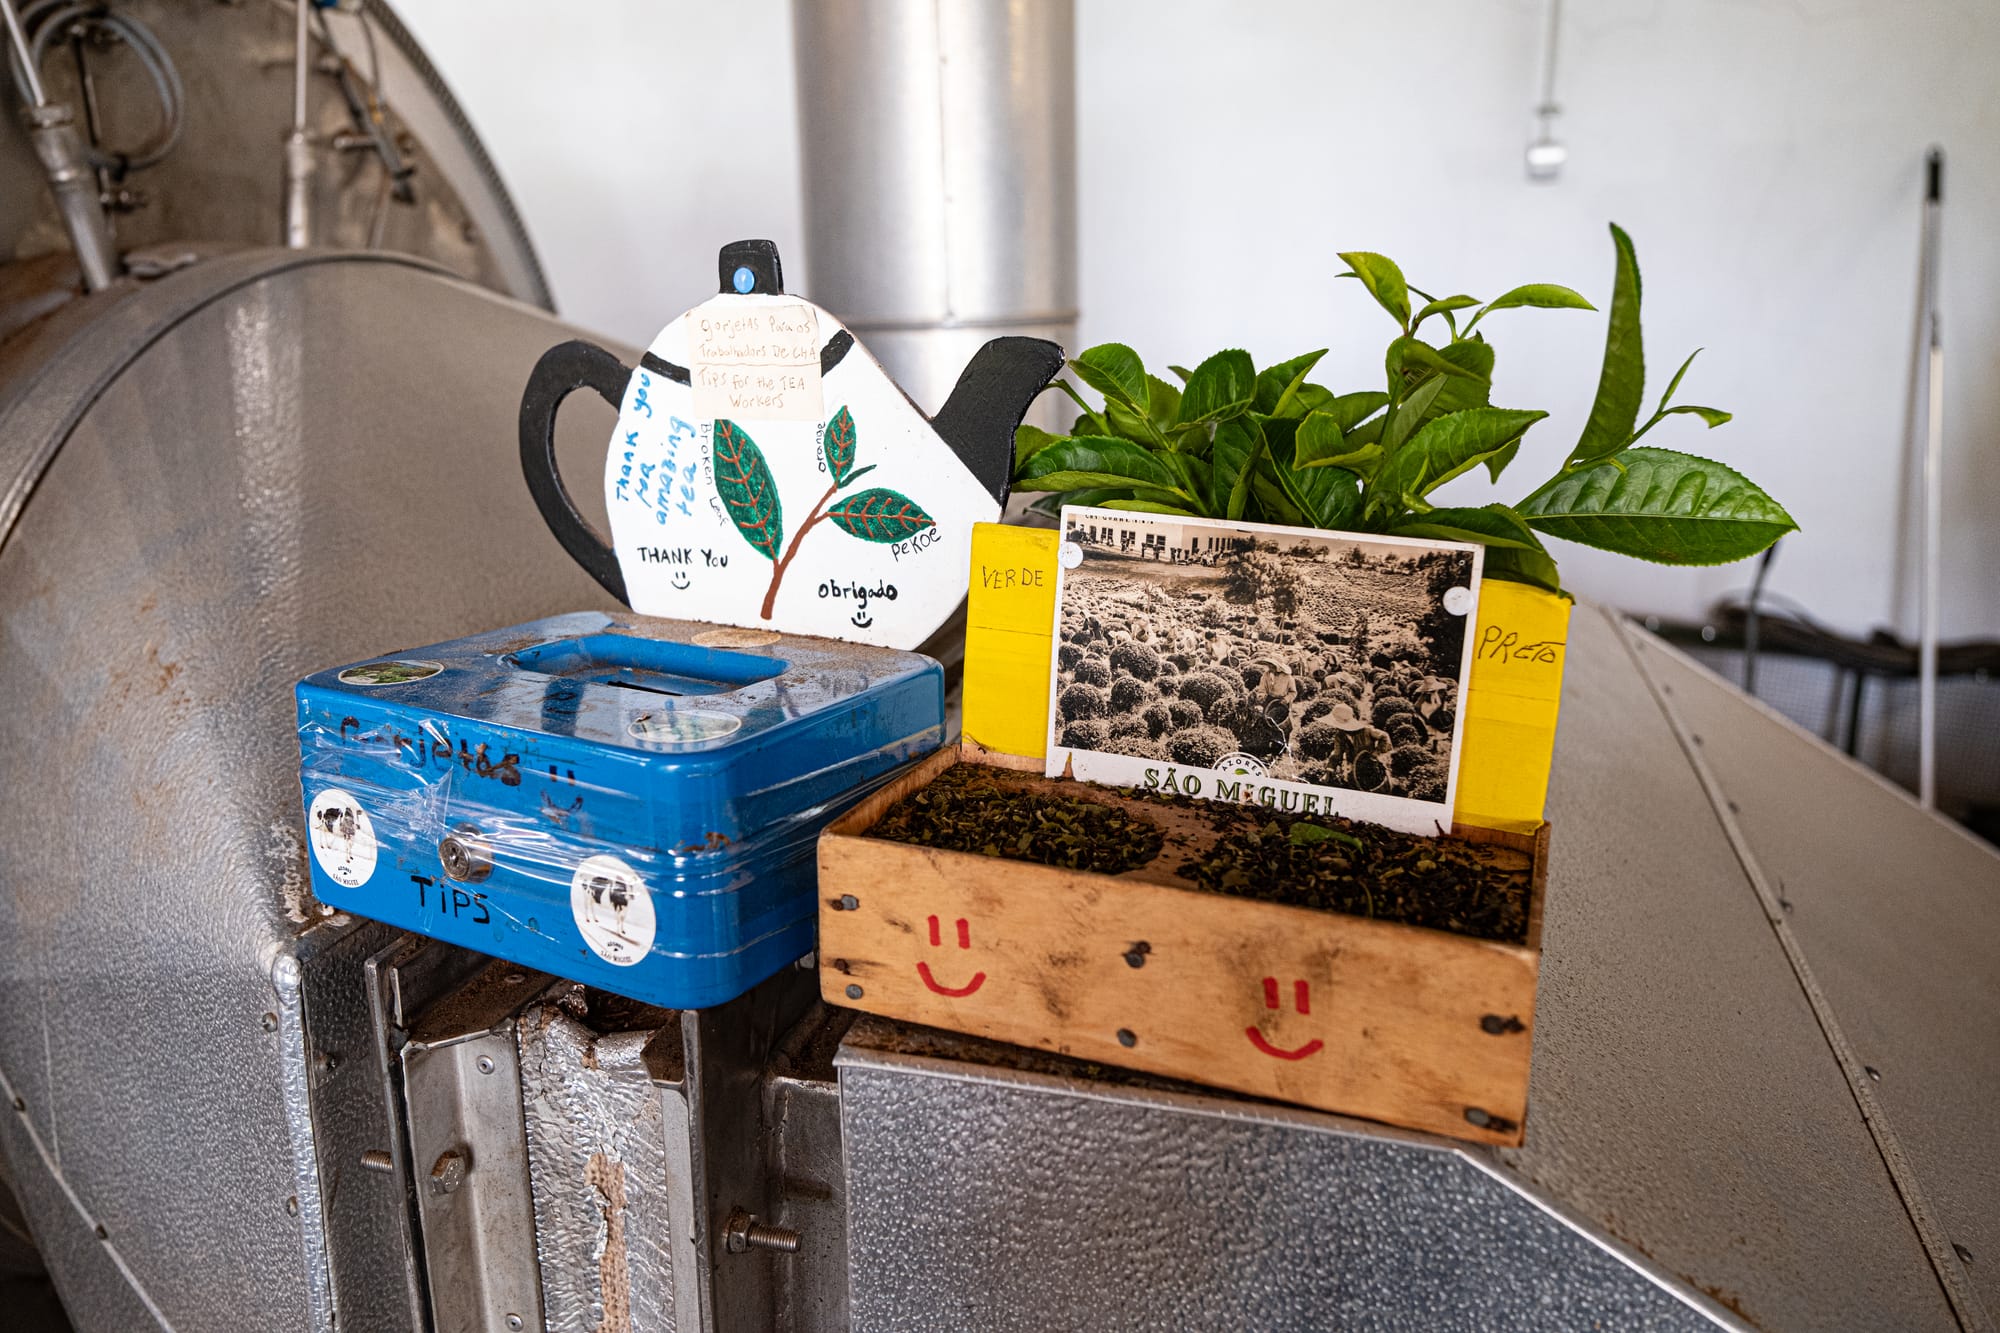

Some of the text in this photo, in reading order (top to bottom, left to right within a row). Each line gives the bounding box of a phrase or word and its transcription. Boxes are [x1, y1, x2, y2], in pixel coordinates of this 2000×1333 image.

[780, 376, 805, 391] TEA
[637, 547, 693, 564] THANK
[982, 565, 1043, 589] VERDE
[1221, 758, 1262, 777] AZORES
[1143, 766, 1201, 795] SÃO
